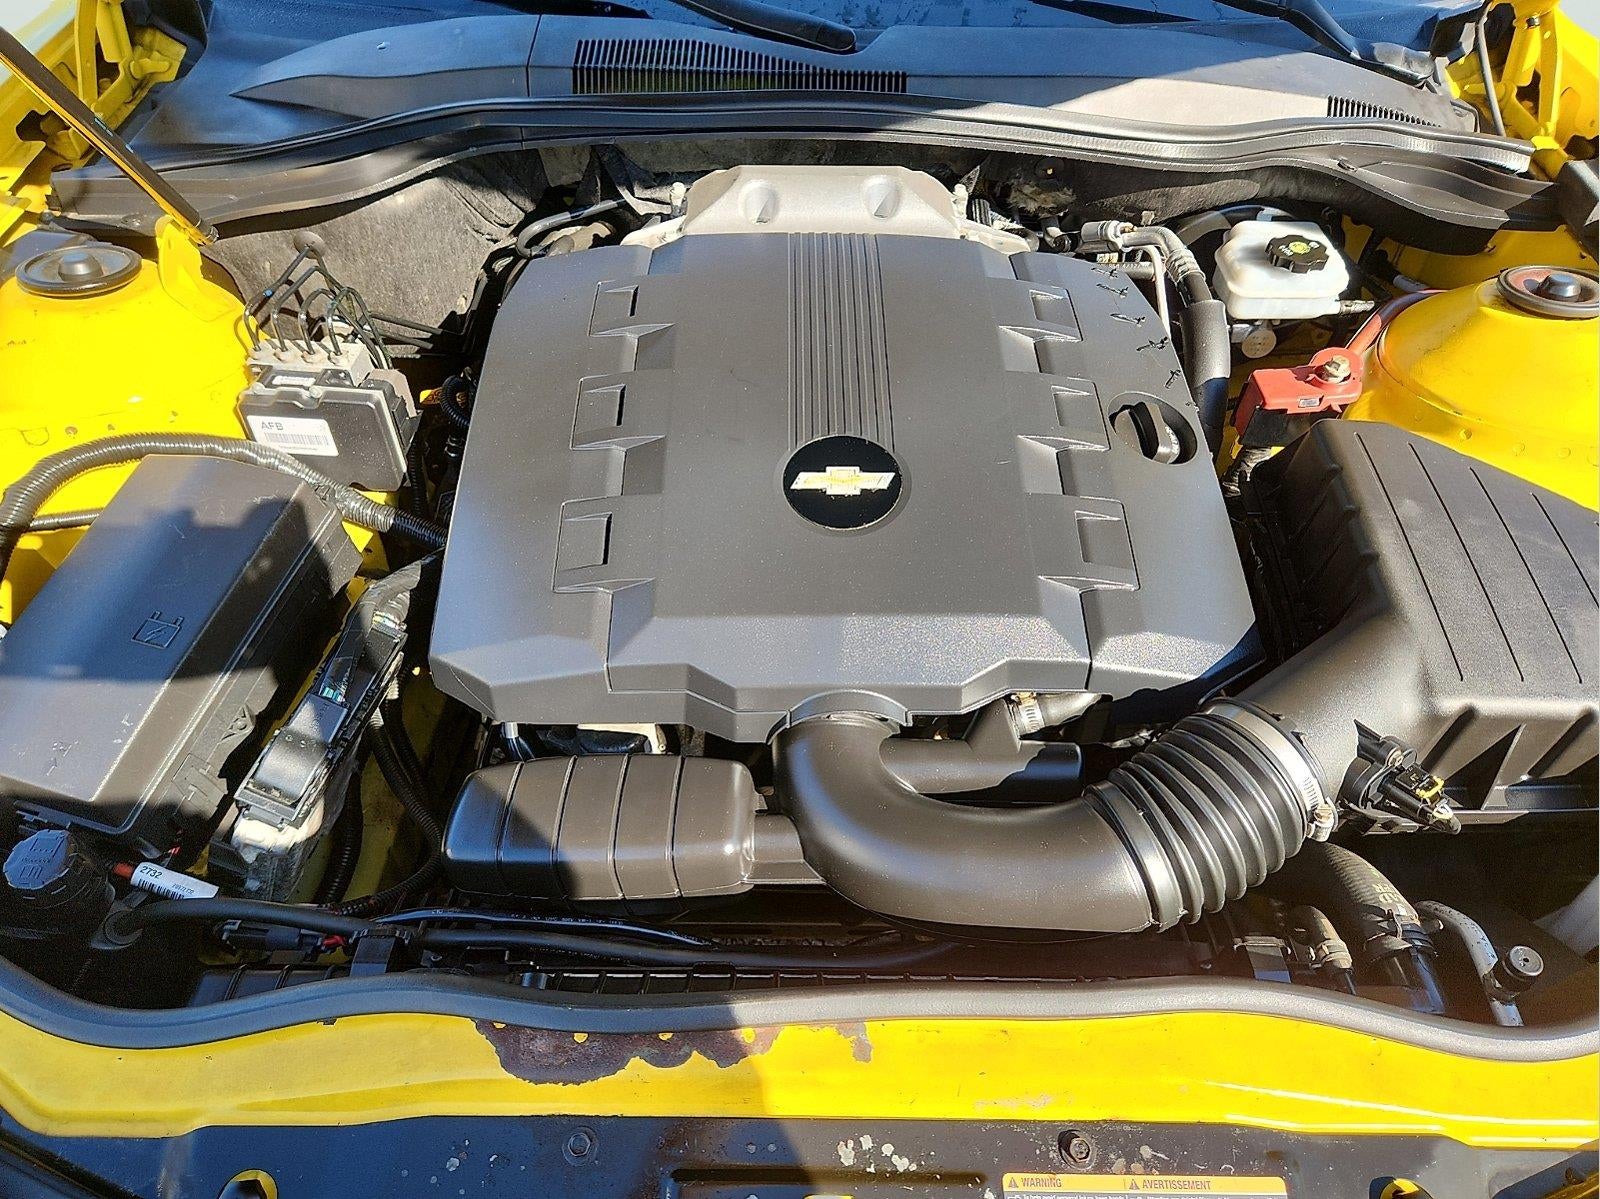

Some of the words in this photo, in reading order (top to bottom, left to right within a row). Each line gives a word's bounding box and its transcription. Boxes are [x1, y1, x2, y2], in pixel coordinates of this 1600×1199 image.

[261, 421, 284, 431] AFB
[139, 865, 163, 879] 2732
[1021, 1177, 1062, 1188] WARNING
[1142, 1179, 1211, 1190] AVERTISSEMENT
